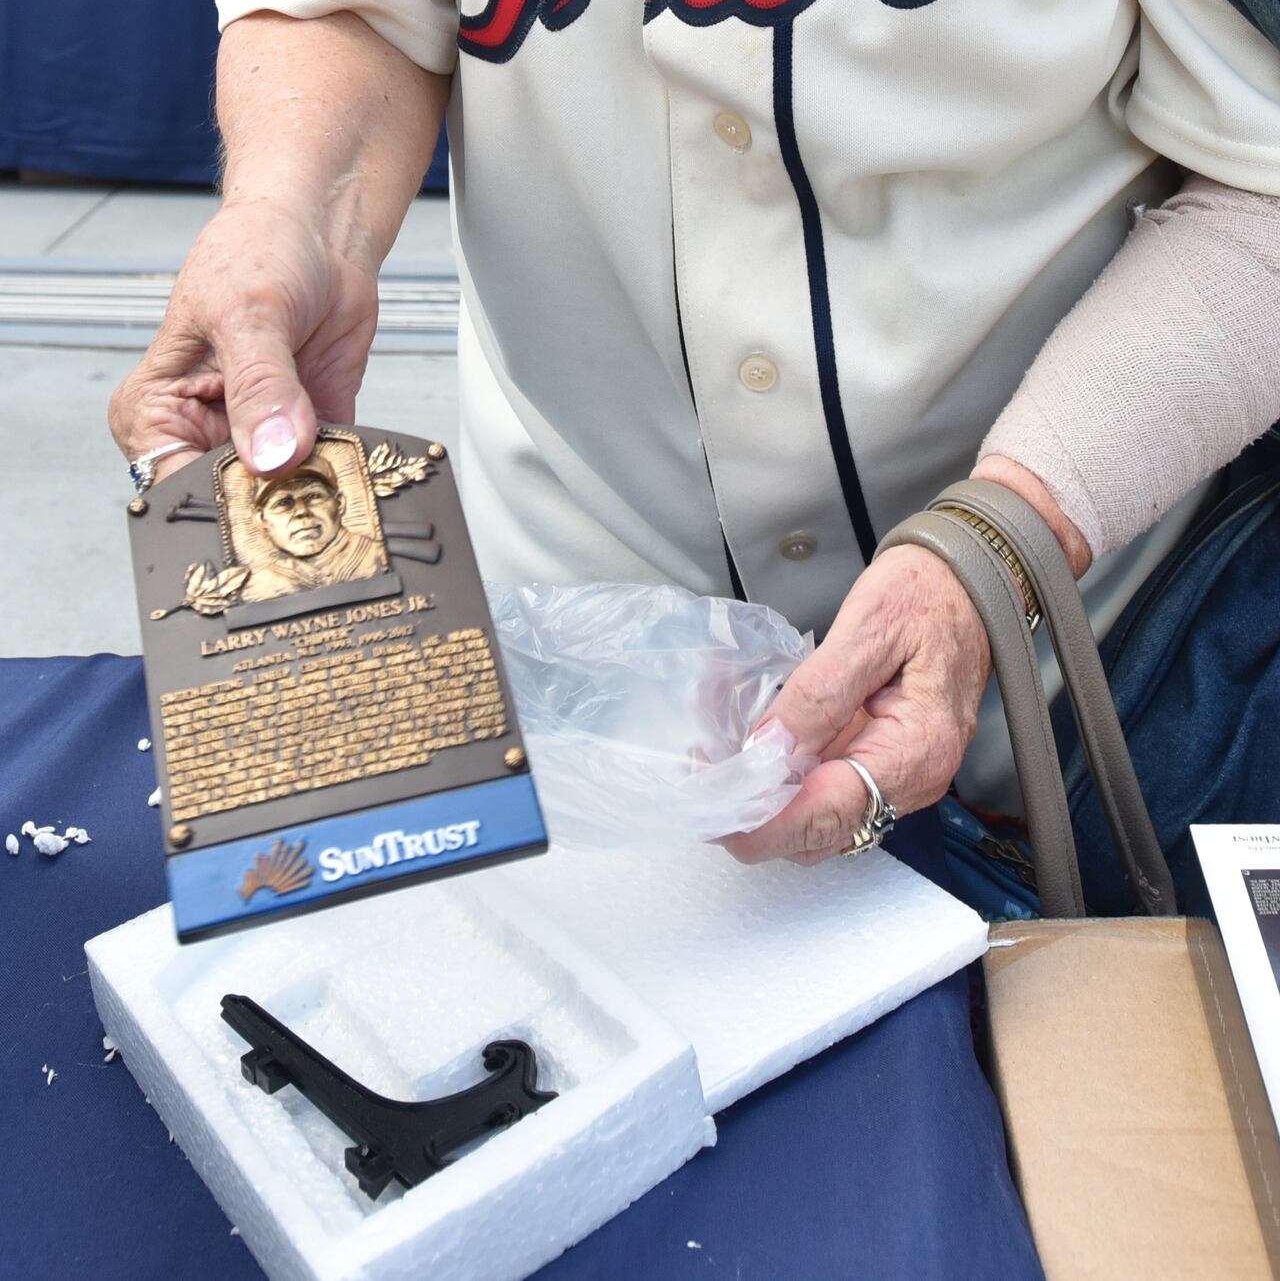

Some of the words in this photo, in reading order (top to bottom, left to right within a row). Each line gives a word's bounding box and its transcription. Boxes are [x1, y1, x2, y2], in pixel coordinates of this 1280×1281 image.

[200, 627, 269, 658] LARRY
[270, 613, 341, 641] WAYNE
[344, 598, 403, 626] JONES
[407, 595, 437, 613] JR.
